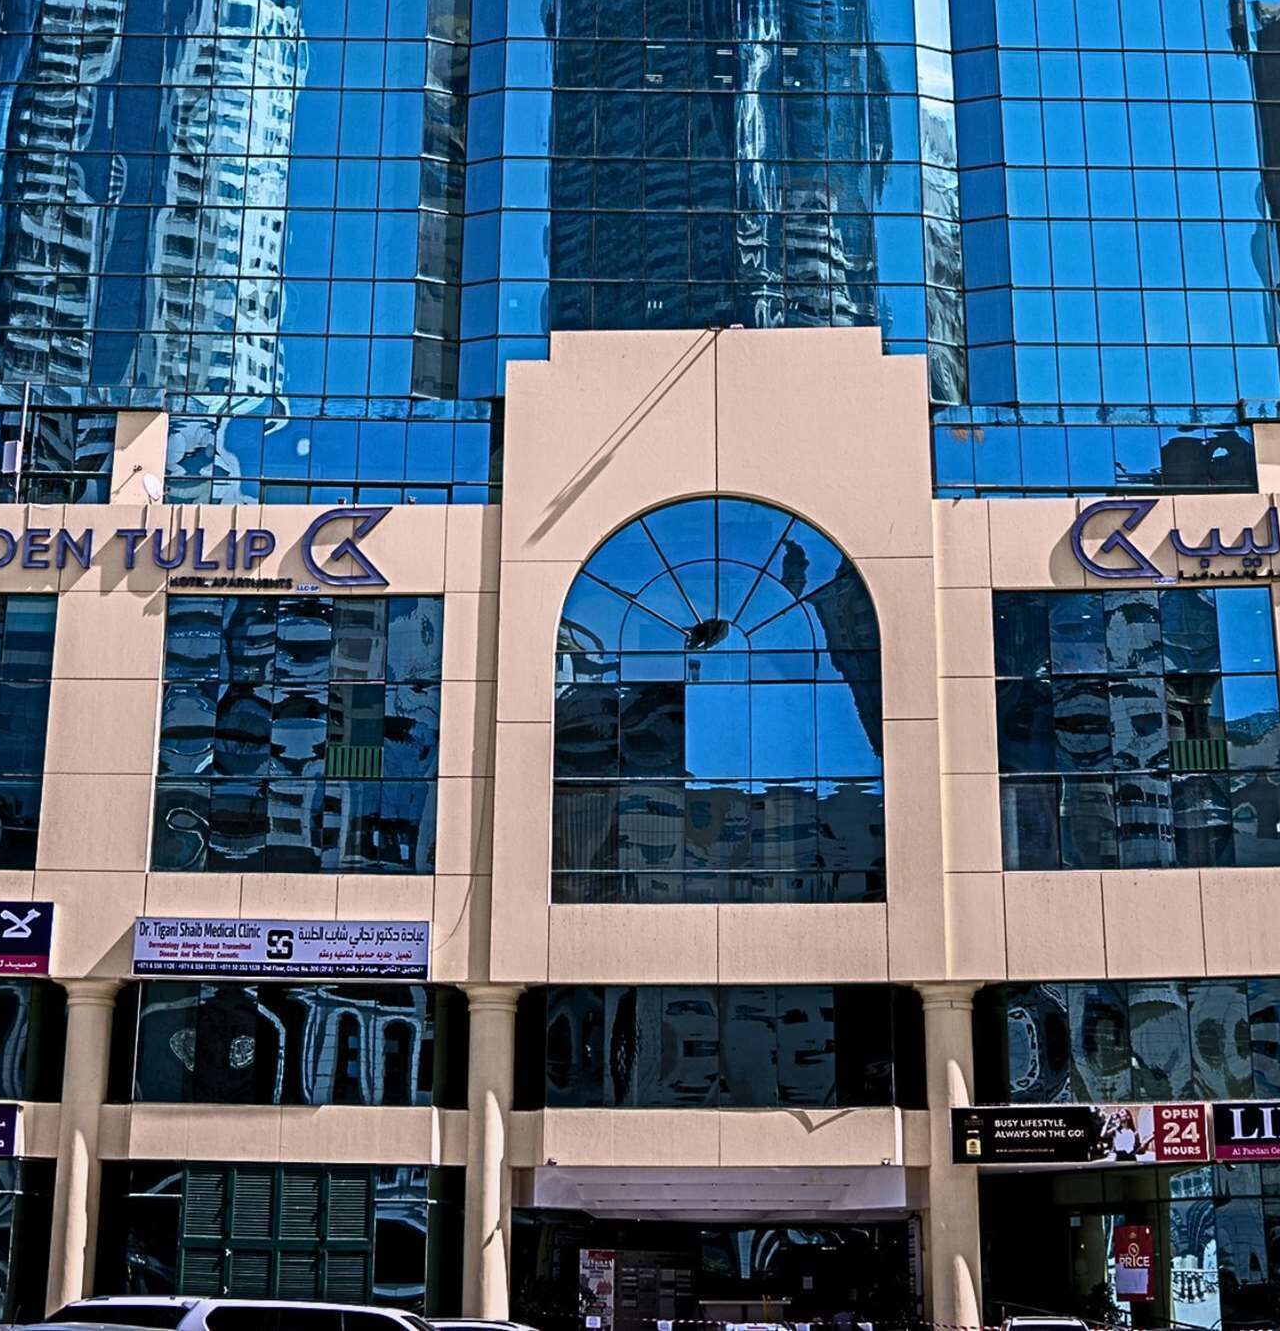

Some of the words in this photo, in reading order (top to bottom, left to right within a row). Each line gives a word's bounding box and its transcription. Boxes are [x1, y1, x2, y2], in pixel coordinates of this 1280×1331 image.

[117, 528, 276, 570] TULIP
[139, 922, 152, 937] Dr.
[153, 922, 178, 940] Tigani
[180, 922, 202, 938] Shaib
[204, 923, 236, 938] Medical
[238, 923, 261, 938] Clinic
[298, 926, 323, 945] الطبية
[375, 927, 400, 945] دكتور
[401, 927, 424, 946] عيادة
[1162, 1108, 1199, 1119] OPEN
[994, 1119, 1018, 1127] BUSY
[994, 1130, 1030, 1138] ALWAYS
[1031, 1130, 1046, 1138] ON
[1047, 1130, 1066, 1138] THE
[1067, 1129, 1085, 1138] GO!
[1162, 1121, 1200, 1143] 24
[1163, 1145, 1201, 1155] HOURS
[1232, 1147, 1241, 1156] Al
[1242, 1147, 1270, 1156] Fardan
[1119, 1255, 1151, 1268] PRICE
